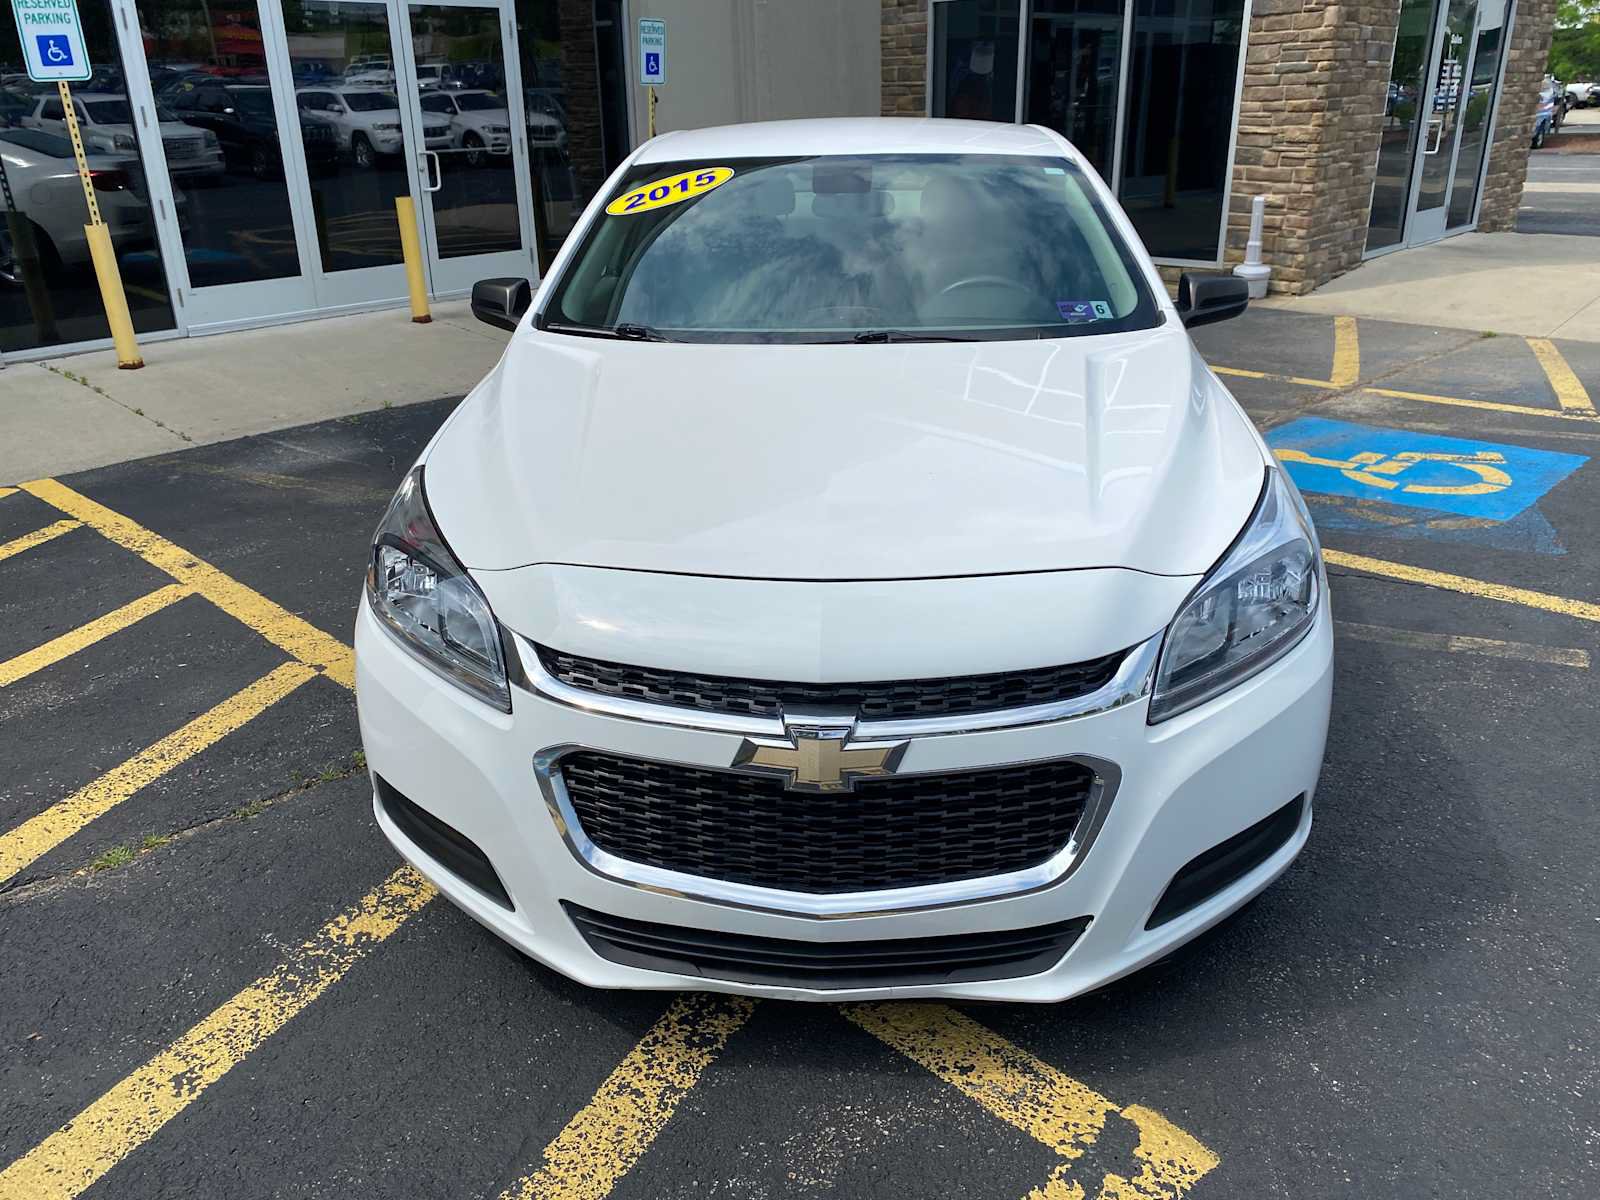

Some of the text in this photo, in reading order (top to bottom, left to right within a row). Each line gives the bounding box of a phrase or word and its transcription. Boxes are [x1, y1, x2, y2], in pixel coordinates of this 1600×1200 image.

[17, 0, 71, 8] RESERVED
[23, 12, 72, 24] PARKING
[624, 170, 717, 210] 2015
[1095, 304, 1105, 314] 6
